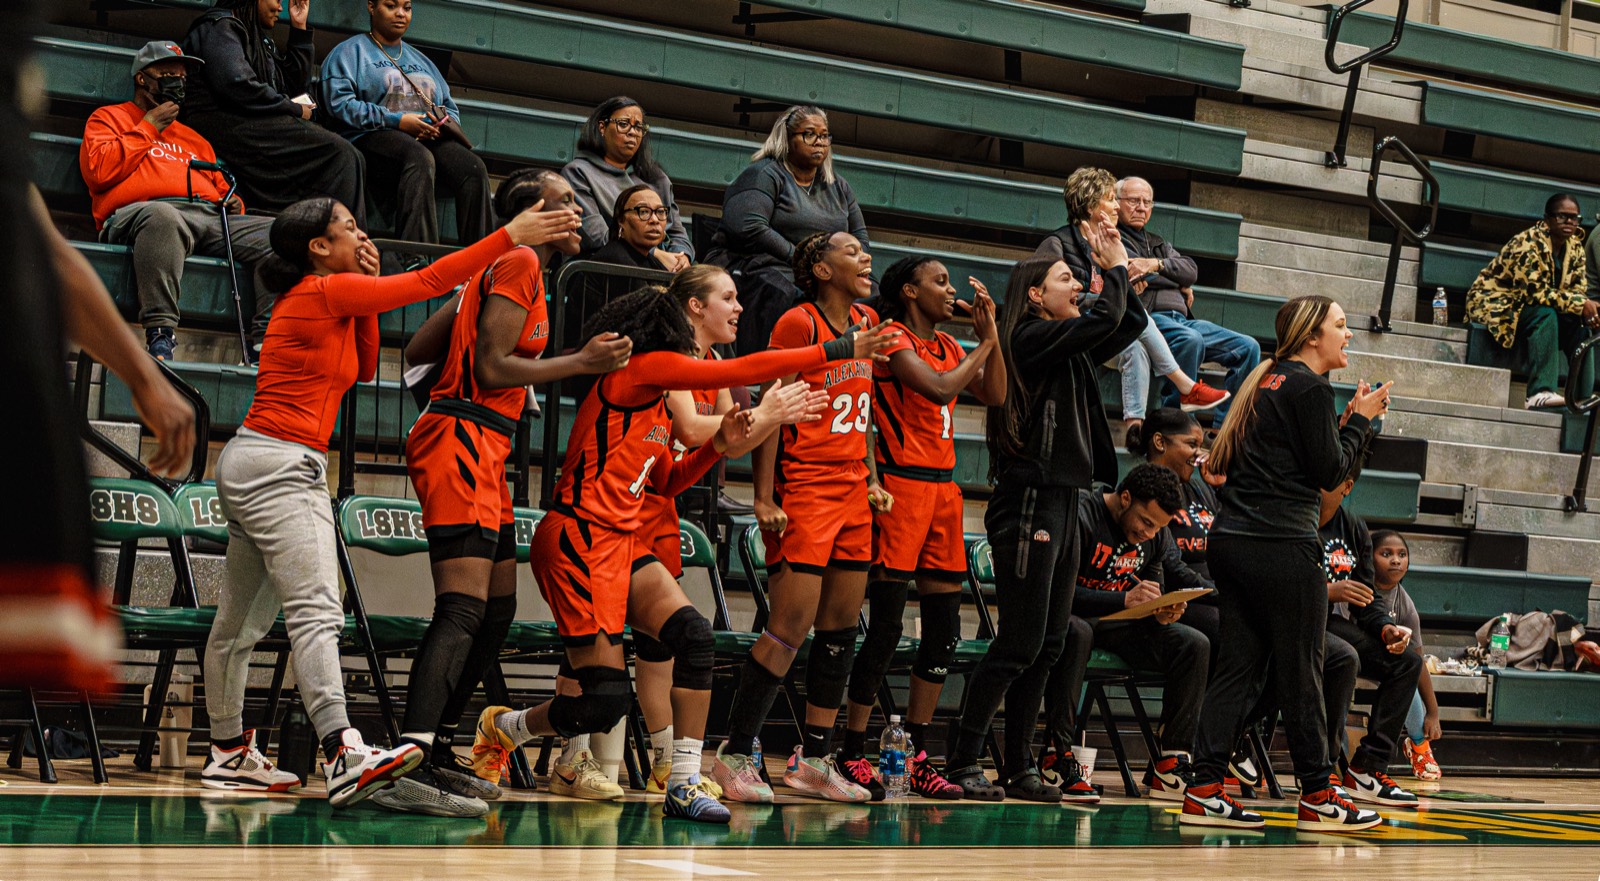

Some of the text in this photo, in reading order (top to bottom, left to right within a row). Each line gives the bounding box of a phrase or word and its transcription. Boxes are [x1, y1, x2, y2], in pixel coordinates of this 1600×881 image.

[830, 391, 870, 434] 23
[628, 454, 648, 498] 1
[1176, 537, 1208, 551] EVE
